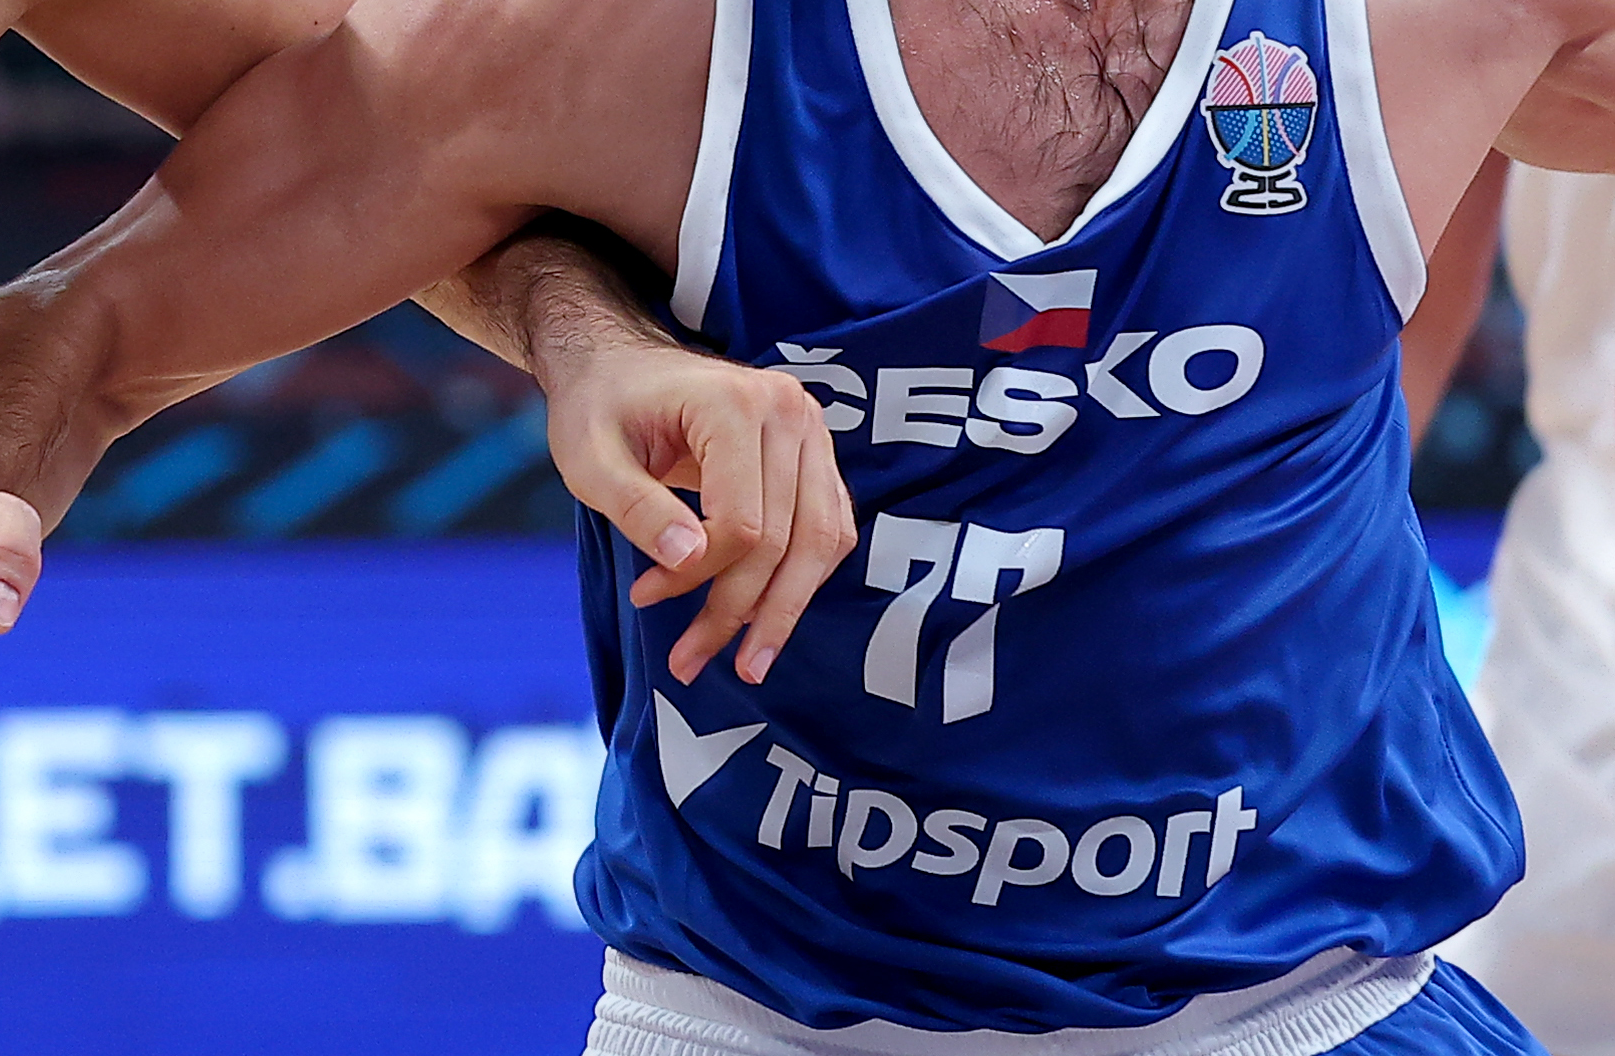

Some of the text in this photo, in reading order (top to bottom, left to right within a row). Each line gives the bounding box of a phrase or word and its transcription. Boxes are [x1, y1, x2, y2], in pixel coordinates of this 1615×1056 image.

[1226, 170, 1303, 209] 25
[764, 323, 1265, 455] ČESKO
[863, 512, 1065, 725] 77
[756, 742, 1257, 906] Tipsport
